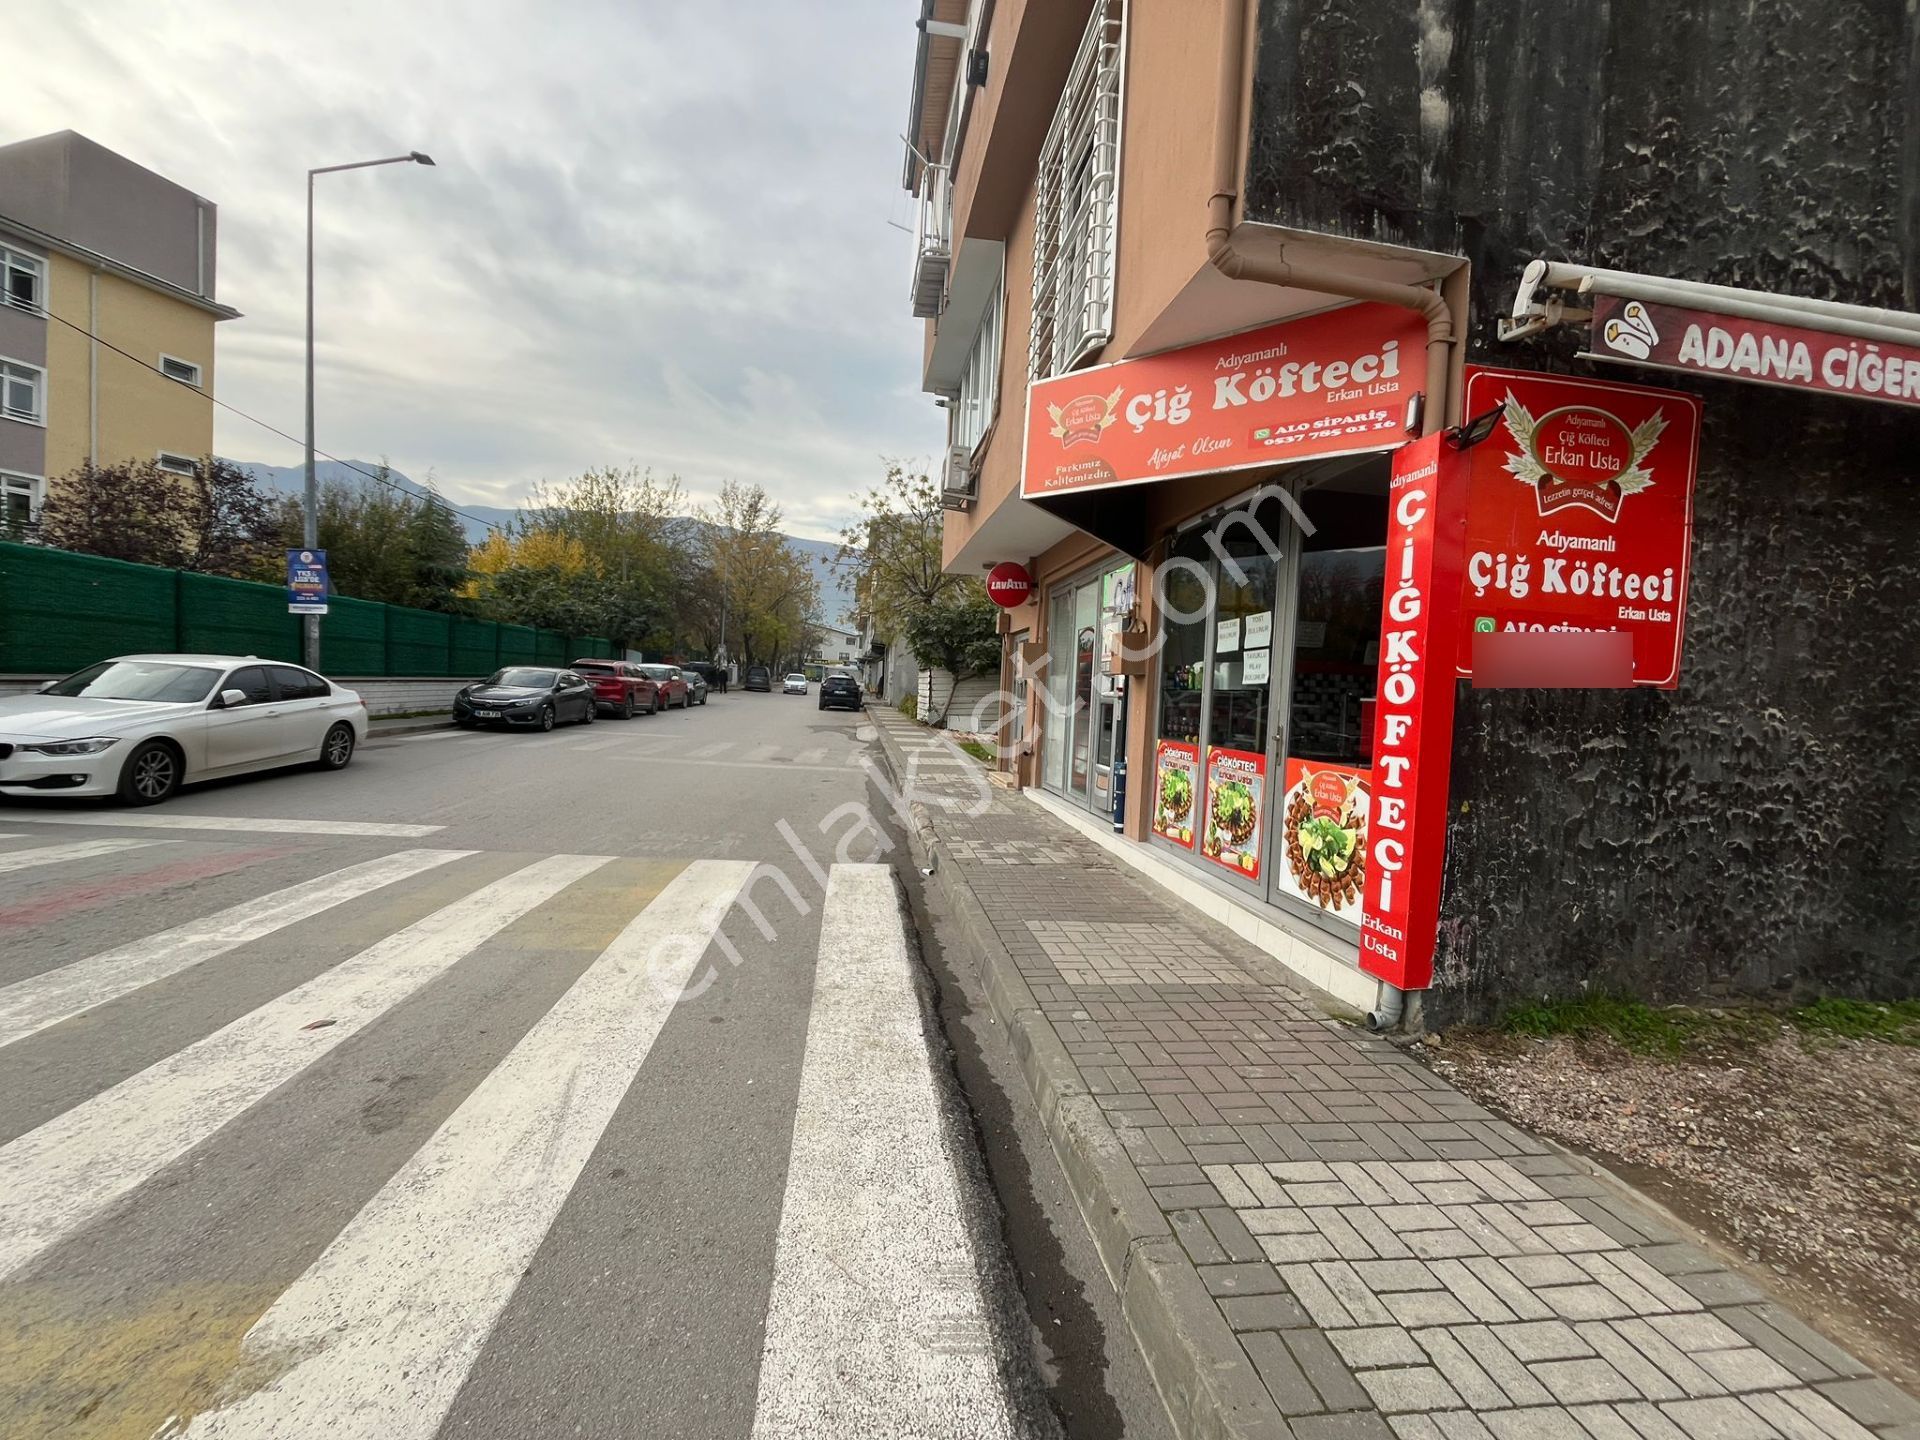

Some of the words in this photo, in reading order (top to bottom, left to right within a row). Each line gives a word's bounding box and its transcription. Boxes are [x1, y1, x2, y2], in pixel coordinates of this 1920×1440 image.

[1215, 343, 1287, 370] Adıyamanlı
[1678, 324, 1813, 383] ADANA
[1125, 384, 1192, 433] Çiğ
[1212, 340, 1400, 410] Köfteci
[1327, 388, 1362, 404] Erkan
[1368, 382, 1399, 396] Usta
[1264, 434, 1306, 446] 0537
[1309, 428, 1342, 440] 785
[1345, 425, 1368, 433] 01
[1373, 420, 1396, 430] 16
[1275, 423, 1310, 435] ALO
[1313, 409, 1388, 429] SİPARİŞ
[1565, 414, 1606, 429] Adıyamanlı
[1559, 430, 1575, 447] Çiğ
[1578, 432, 1610, 447] Köfteci
[1147, 444, 1185, 469] Afiyet
[1192, 436, 1233, 455] Olsun
[1545, 445, 1584, 467] Erkan
[1590, 450, 1620, 471] Usta
[1056, 460, 1100, 475] Farkımız
[1543, 488, 1571, 504] Lezzetin
[1572, 488, 1596, 499] gerçek
[1536, 530, 1616, 553] Adıyamanlı
[990, 578, 1028, 590] LAVAZZA
[1469, 552, 1530, 598] Çiğ
[1542, 557, 1674, 602] Köfteci
[1618, 606, 1646, 621] Erkan
[1649, 608, 1671, 622] Usta
[1361, 912, 1403, 940] Erkan
[1364, 934, 1398, 961] Usta
